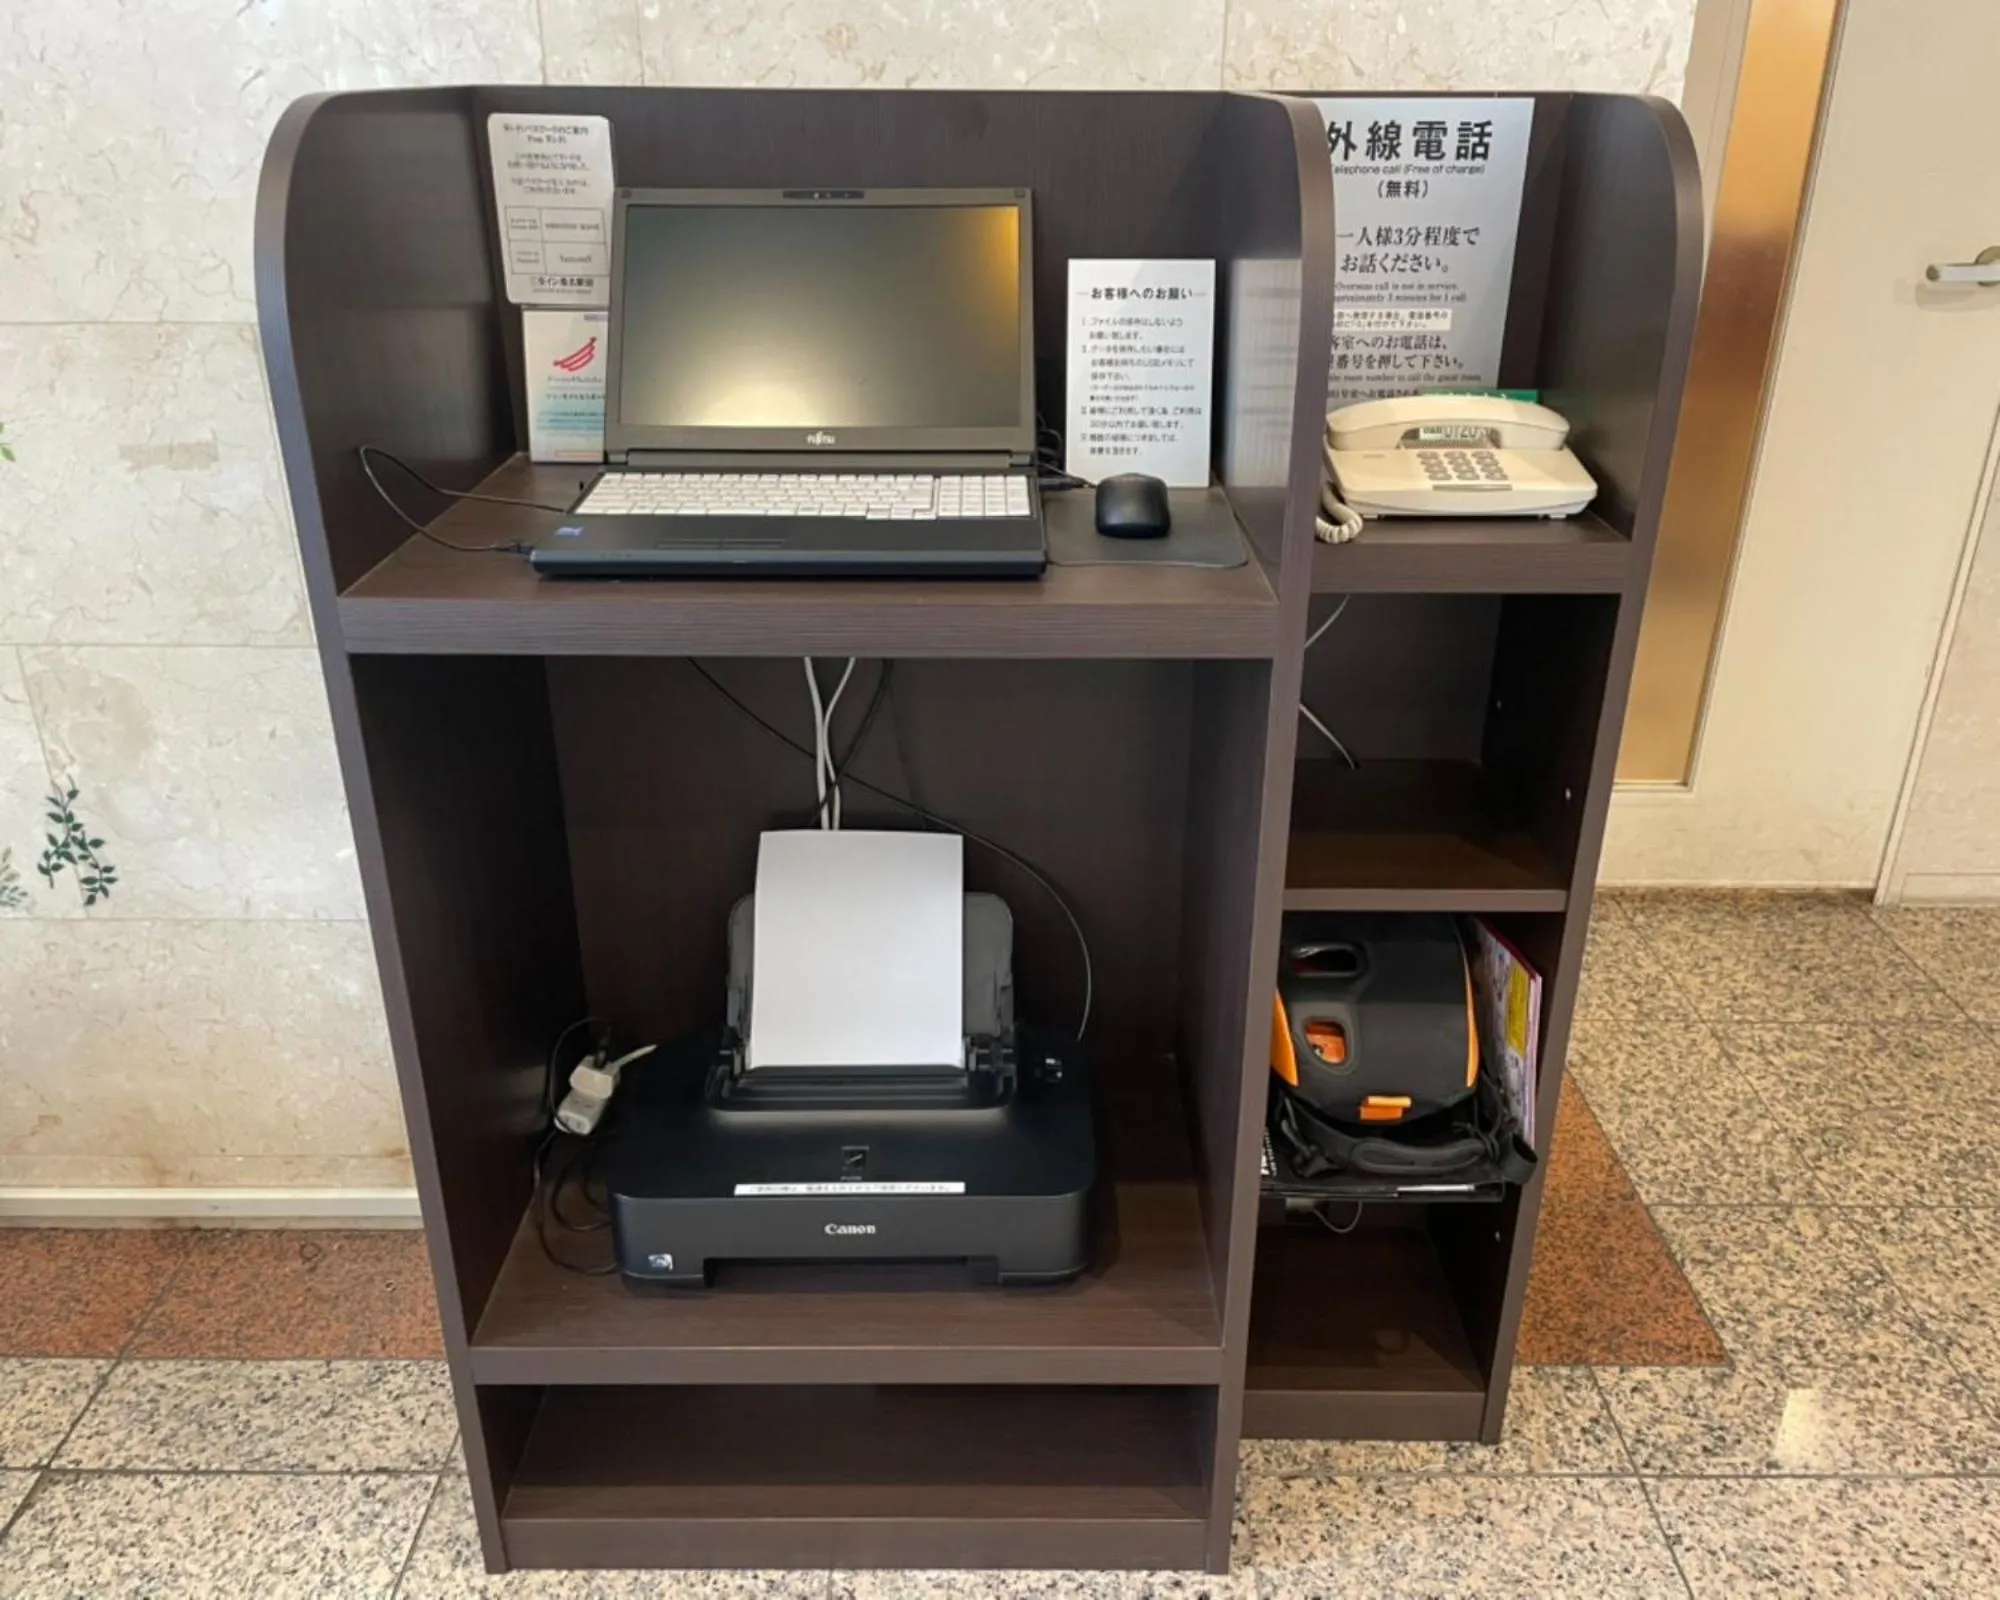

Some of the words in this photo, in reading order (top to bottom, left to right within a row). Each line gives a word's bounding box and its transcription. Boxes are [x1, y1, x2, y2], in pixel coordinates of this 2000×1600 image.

[1327, 120, 1493, 161] 外線電話
[1334, 164, 1381, 175] elephone
[1340, 252, 1449, 274] お話ください。
[1091, 287, 1193, 300] お客様へのお願い
[1329, 353, 1464, 370] 番号を押して下さい。
[824, 1223, 876, 1234] Canon
